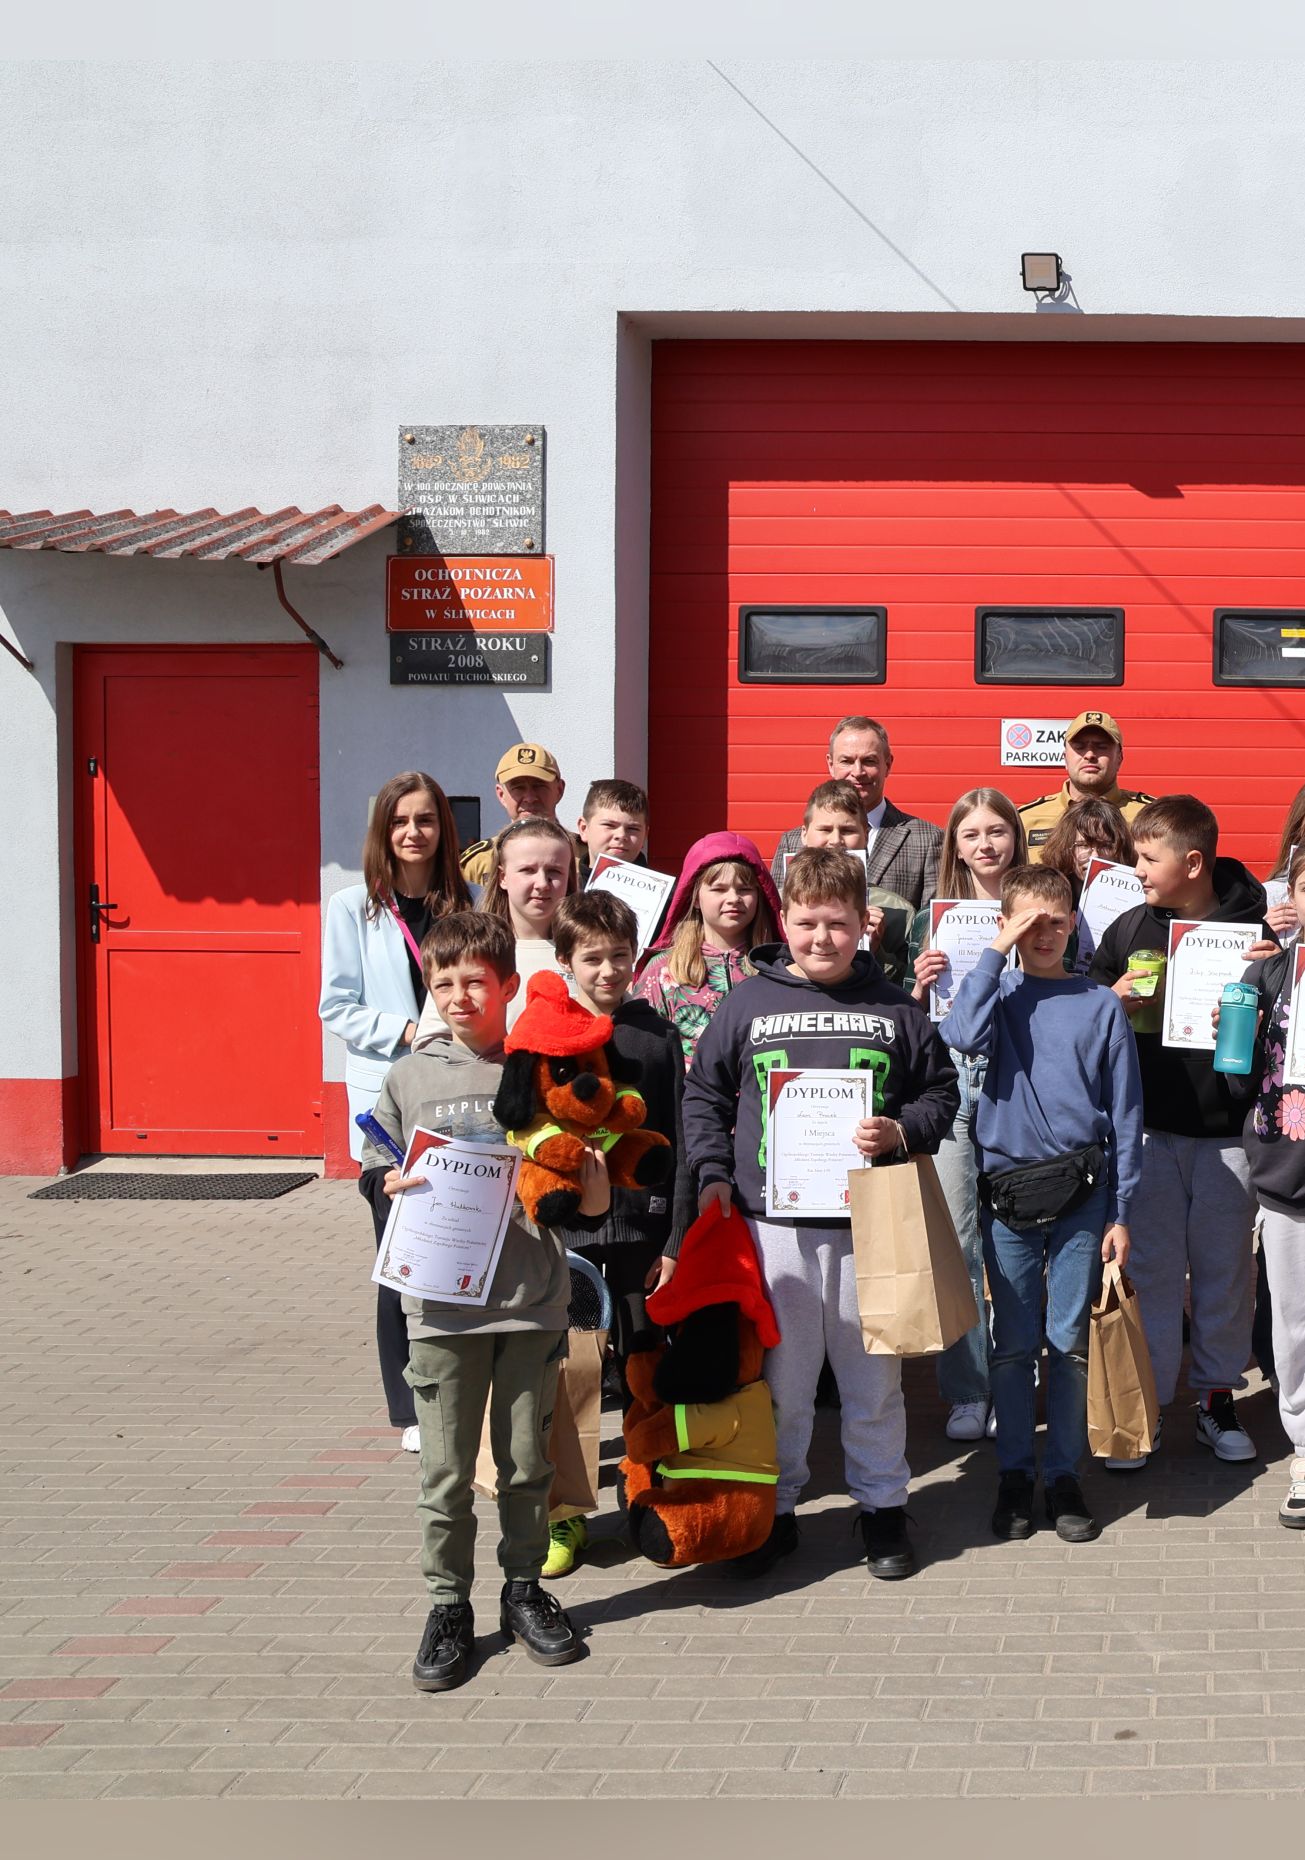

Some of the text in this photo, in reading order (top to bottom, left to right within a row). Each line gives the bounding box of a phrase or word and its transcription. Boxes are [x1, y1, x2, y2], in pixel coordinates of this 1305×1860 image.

[404, 482, 413, 491] W
[417, 482, 431, 491] 100
[482, 482, 533, 491] POWSTANIA
[448, 494, 457, 503] W
[469, 506, 535, 516] OCHOTNIKOM
[414, 568, 522, 581] OCHOTNICZA
[401, 585, 536, 600] STRAŻ POŻARNA
[425, 606, 515, 619] W ŚLIWICACH
[408, 634, 527, 651] STRAŻ ROKU
[447, 654, 484, 668] 2008
[408, 673, 527, 681] POWIATU TUCHOLSKIEGO
[1036, 730, 1067, 743] ZAK
[1006, 752, 1066, 762] PARKOWA
[605, 870, 657, 892] DYPLOM
[1099, 874, 1143, 893] DYPLO
[1185, 937, 1245, 950] DYPLOM
[751, 1011, 895, 1045] MINECRAFT
[786, 1087, 854, 1099] DYPLOM
[435, 1100, 495, 1117] EXPLO
[809, 1129, 835, 1139] Miejsca
[425, 1153, 502, 1179] DYPLOM
